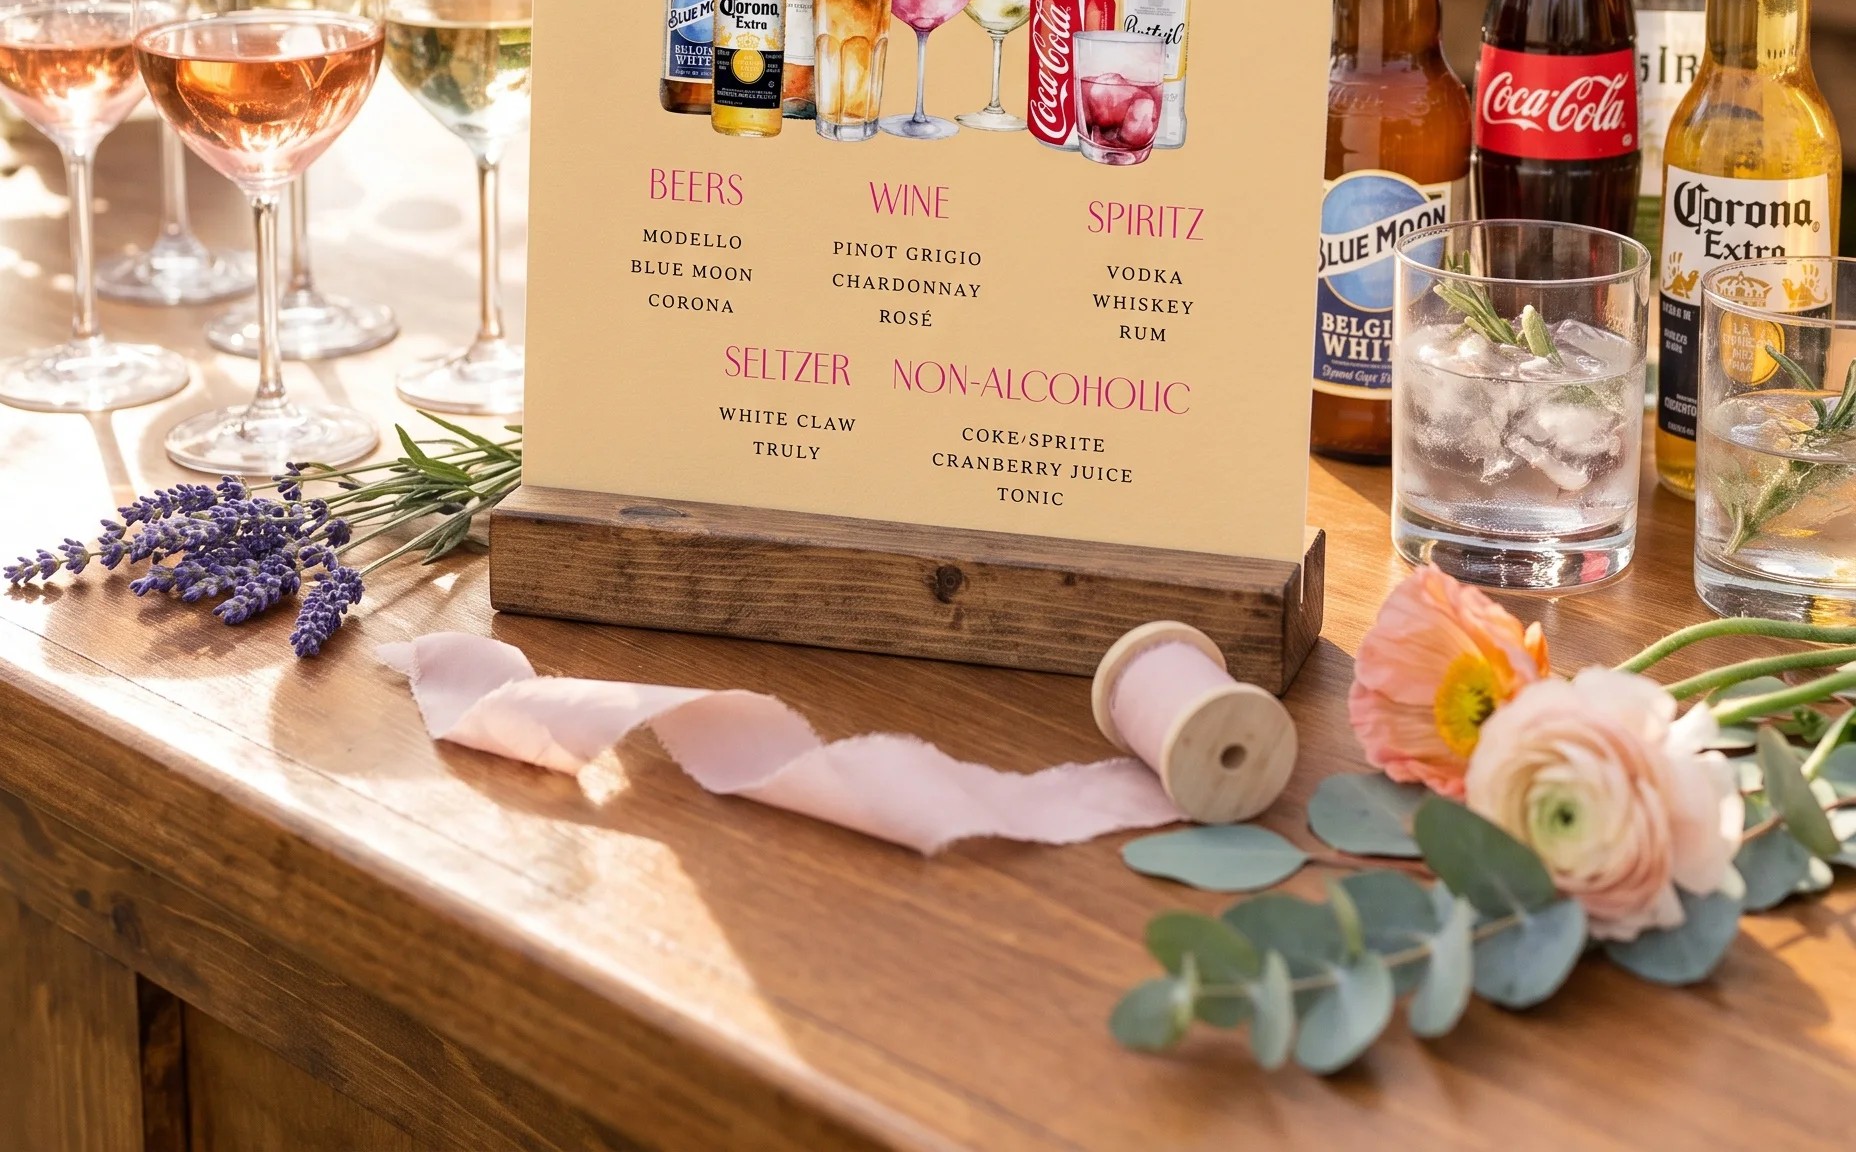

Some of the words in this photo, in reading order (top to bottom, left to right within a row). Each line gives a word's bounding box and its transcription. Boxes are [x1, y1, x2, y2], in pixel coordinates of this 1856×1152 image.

[668, 5, 698, 29] BLUE
[736, 16, 768, 30] Extra
[1482, 71, 1630, 133] Coca-Cola
[649, 169, 742, 205] BEERS
[870, 182, 949, 218] WINE
[1673, 181, 1814, 235] Corona
[1088, 201, 1203, 240] SPIRITZ
[1376, 205, 1446, 254] MOON
[643, 229, 741, 249] MODELLO
[1704, 228, 1786, 261] Extra
[833, 241, 897, 259] PINOT
[906, 247, 981, 266] GRIGIO
[631, 260, 683, 276] BLUE
[692, 265, 752, 281] MOON
[1107, 266, 1182, 284] VODKA
[833, 274, 980, 297] CHARDONNAY
[649, 294, 733, 313] CORONA
[1093, 294, 1193, 314] WHISKEY
[879, 310, 931, 326] ROSÉ
[1120, 325, 1166, 342] RUM
[725, 346, 850, 385] SELTZER
[894, 359, 1190, 414] NON-ALCOHOLIC
[719, 407, 787, 426] WHITE
[797, 415, 855, 431] CLAW
[753, 441, 820, 459] TRULY
[962, 428, 1104, 452] COKE/SPRITE
[933, 453, 1062, 476] CRANBERRY
[1071, 465, 1132, 483] JUICE
[997, 487, 1063, 506] TONIC
